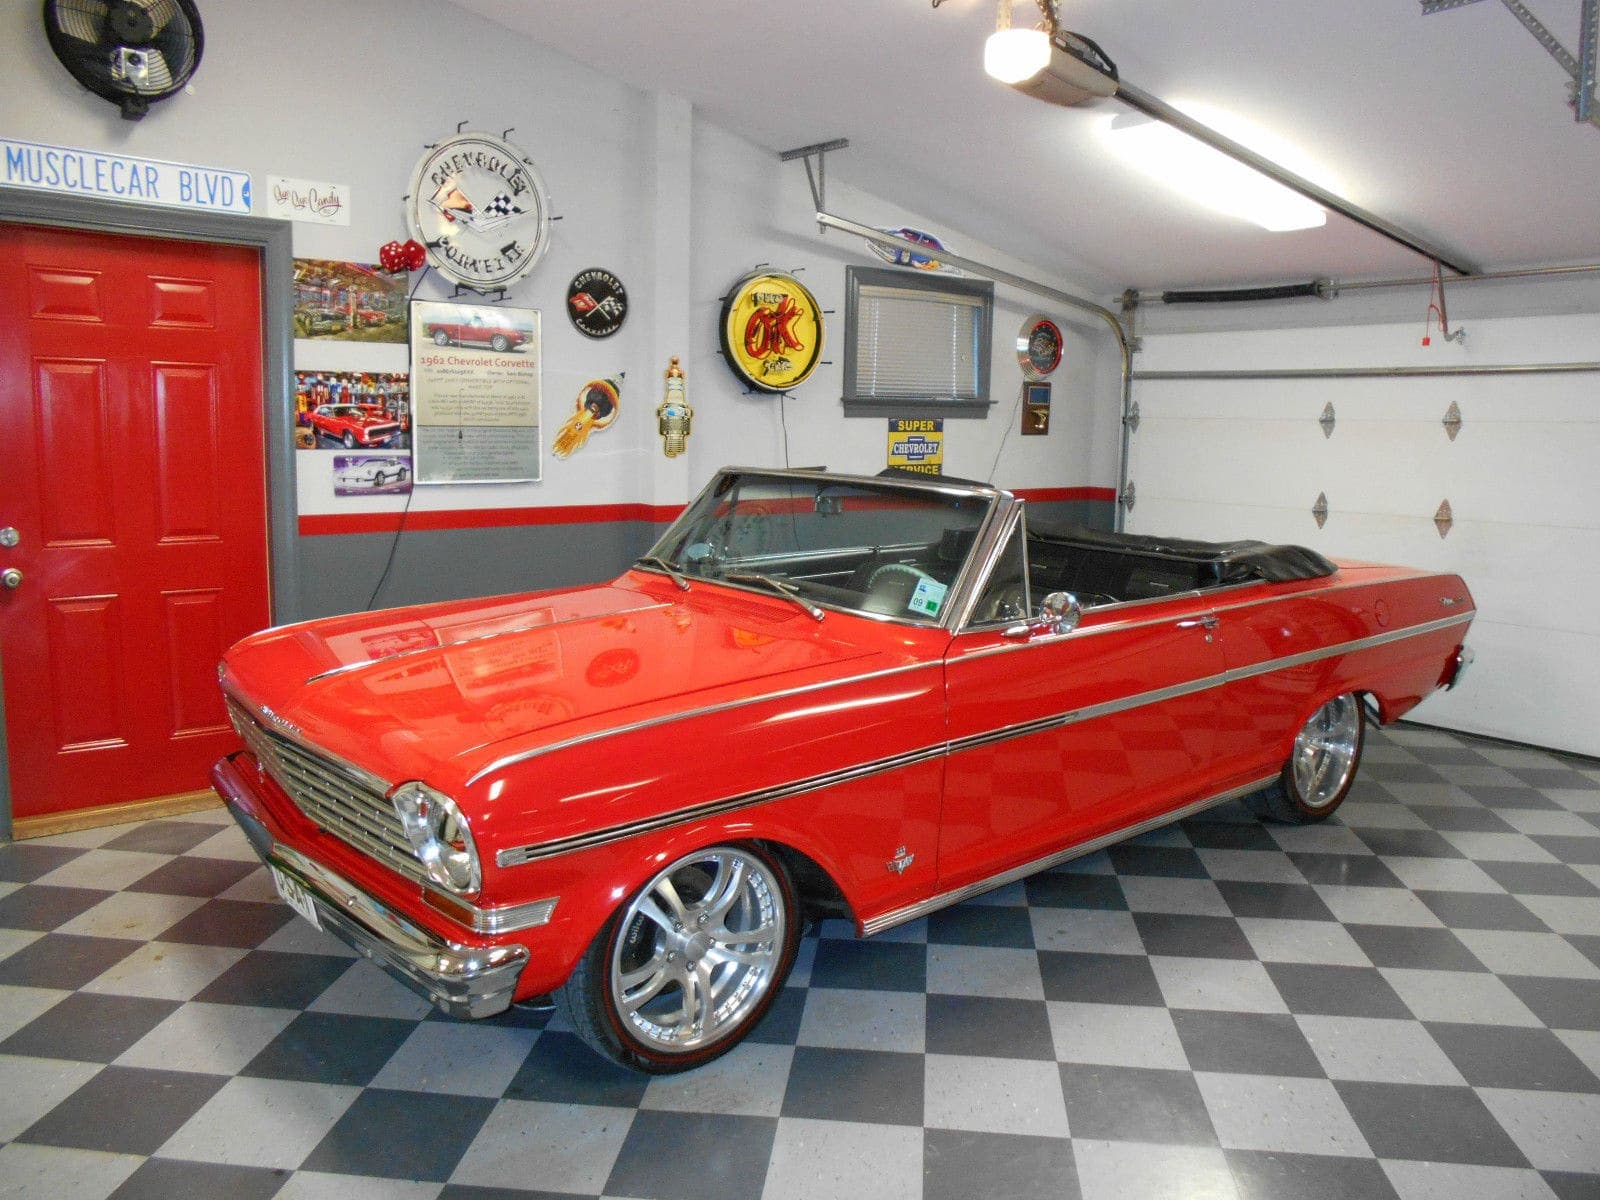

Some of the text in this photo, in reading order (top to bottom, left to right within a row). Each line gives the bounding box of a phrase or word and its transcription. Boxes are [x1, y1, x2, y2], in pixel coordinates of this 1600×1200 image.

[6, 146, 159, 198] MUSCLECAR
[179, 170, 233, 206] BLVD
[574, 271, 623, 294] CHEVROLET
[744, 298, 804, 360] OK
[420, 356, 535, 368] 1962 Chevrolet Corvette
[898, 420, 935, 431] SUPER
[893, 443, 938, 454] CHEVROLET
[893, 465, 939, 475] RVICE
